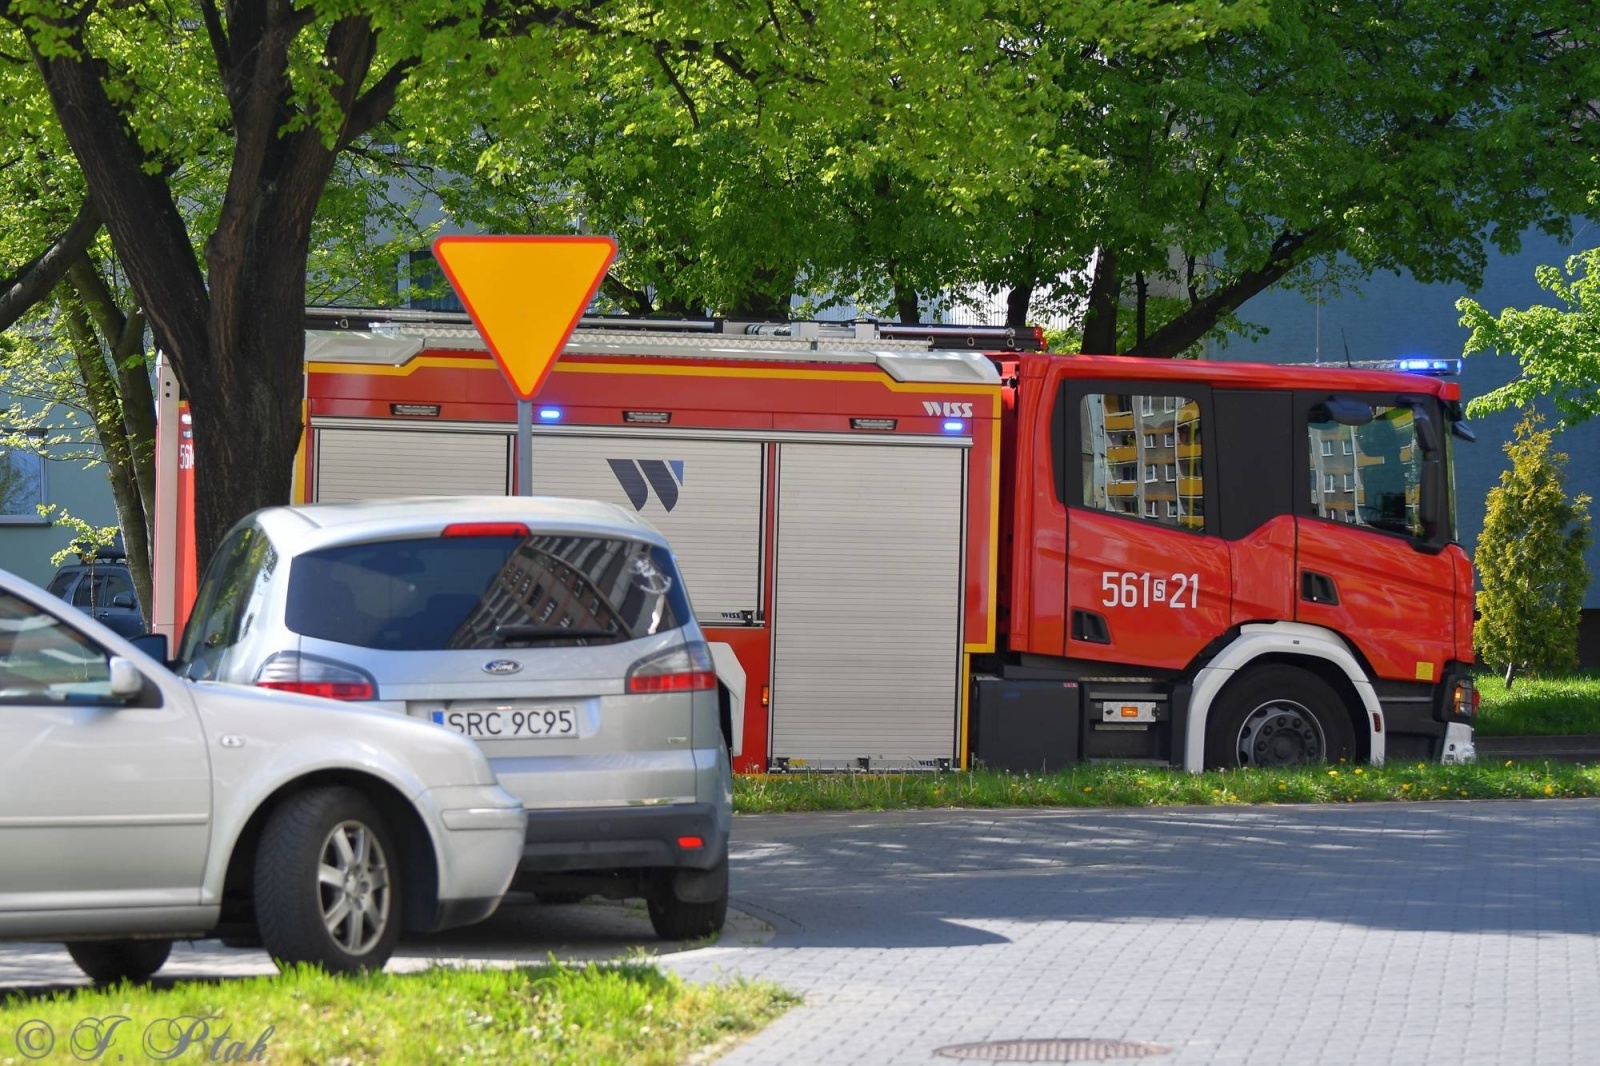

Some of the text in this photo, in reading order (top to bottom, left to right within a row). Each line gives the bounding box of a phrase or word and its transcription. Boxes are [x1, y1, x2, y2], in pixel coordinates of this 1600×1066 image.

[921, 401, 973, 418] WISS
[180, 444, 195, 470] 561
[448, 709, 573, 736] SRC 9C95
